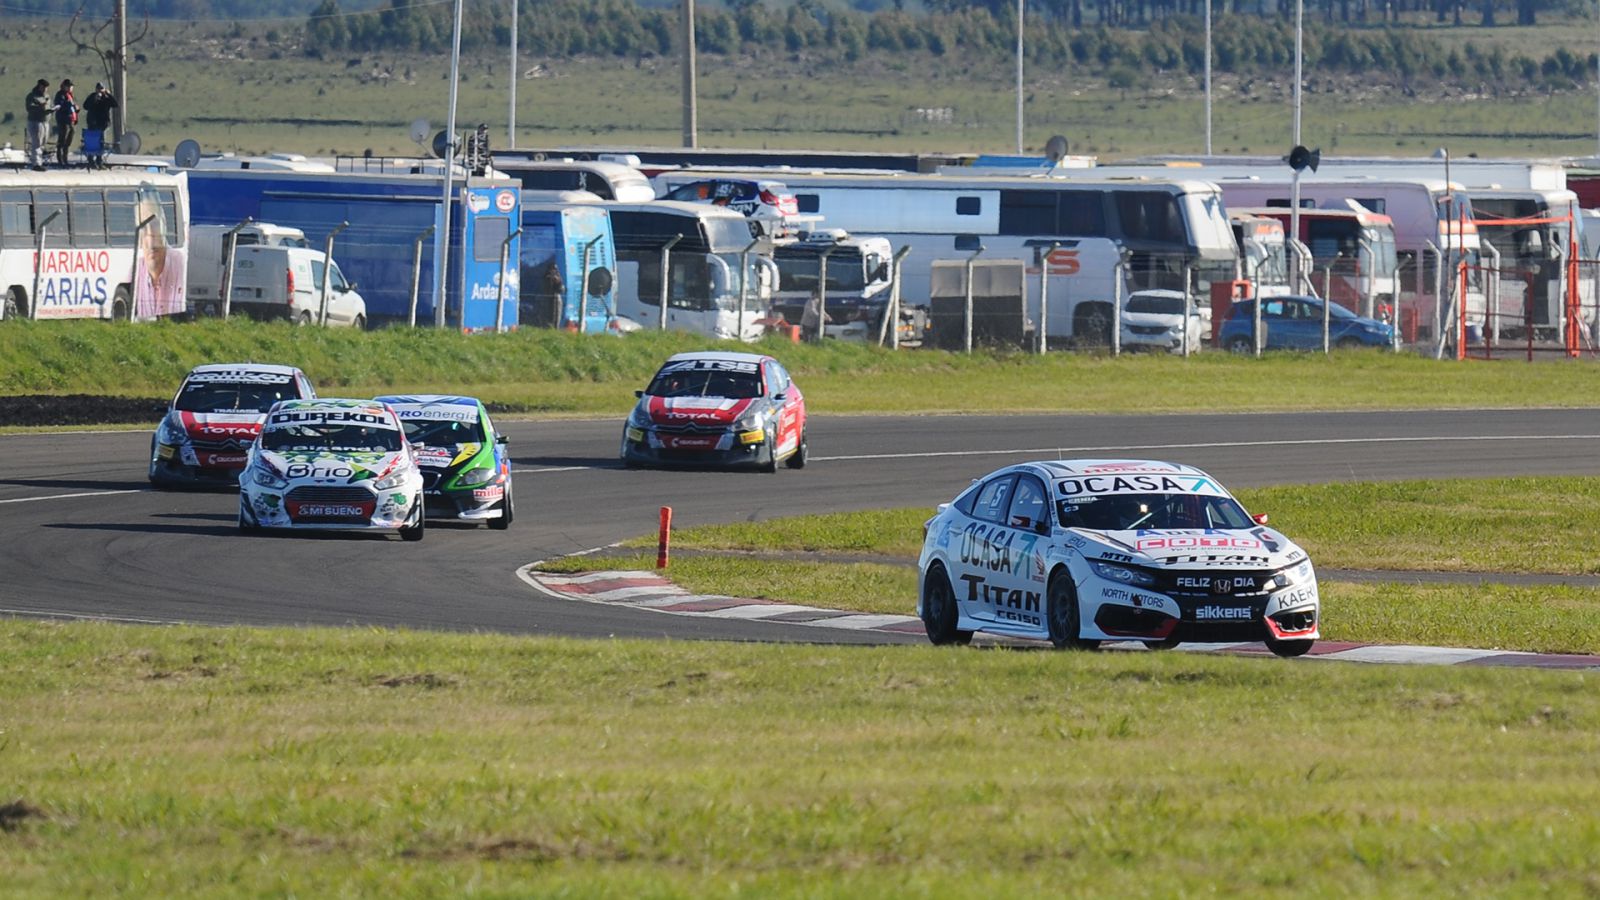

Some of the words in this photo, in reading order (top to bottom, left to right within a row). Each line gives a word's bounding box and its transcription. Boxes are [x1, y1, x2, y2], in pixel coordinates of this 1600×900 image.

[34, 251, 110, 273] MARIANO
[34, 277, 107, 306] ARIAS
[271, 412, 392, 426] DUREKOL
[666, 412, 721, 420] TOTAL
[200, 427, 260, 435] TOTAL
[287, 464, 352, 478] Brio
[1058, 476, 1185, 496] OCASA
[960, 522, 1015, 574] OCASA
[1136, 538, 1260, 551] COTO
[1100, 551, 1133, 562] MTR
[1153, 554, 1269, 565] TITAN
[1176, 577, 1211, 588] FELIZ
[1234, 577, 1255, 588] DIA
[960, 573, 1041, 613] TITAN
[1102, 587, 1129, 601] NORTH
[1131, 592, 1165, 609] MOTORS
[997, 609, 1041, 626] CG150
[1196, 605, 1252, 620] sikkens
